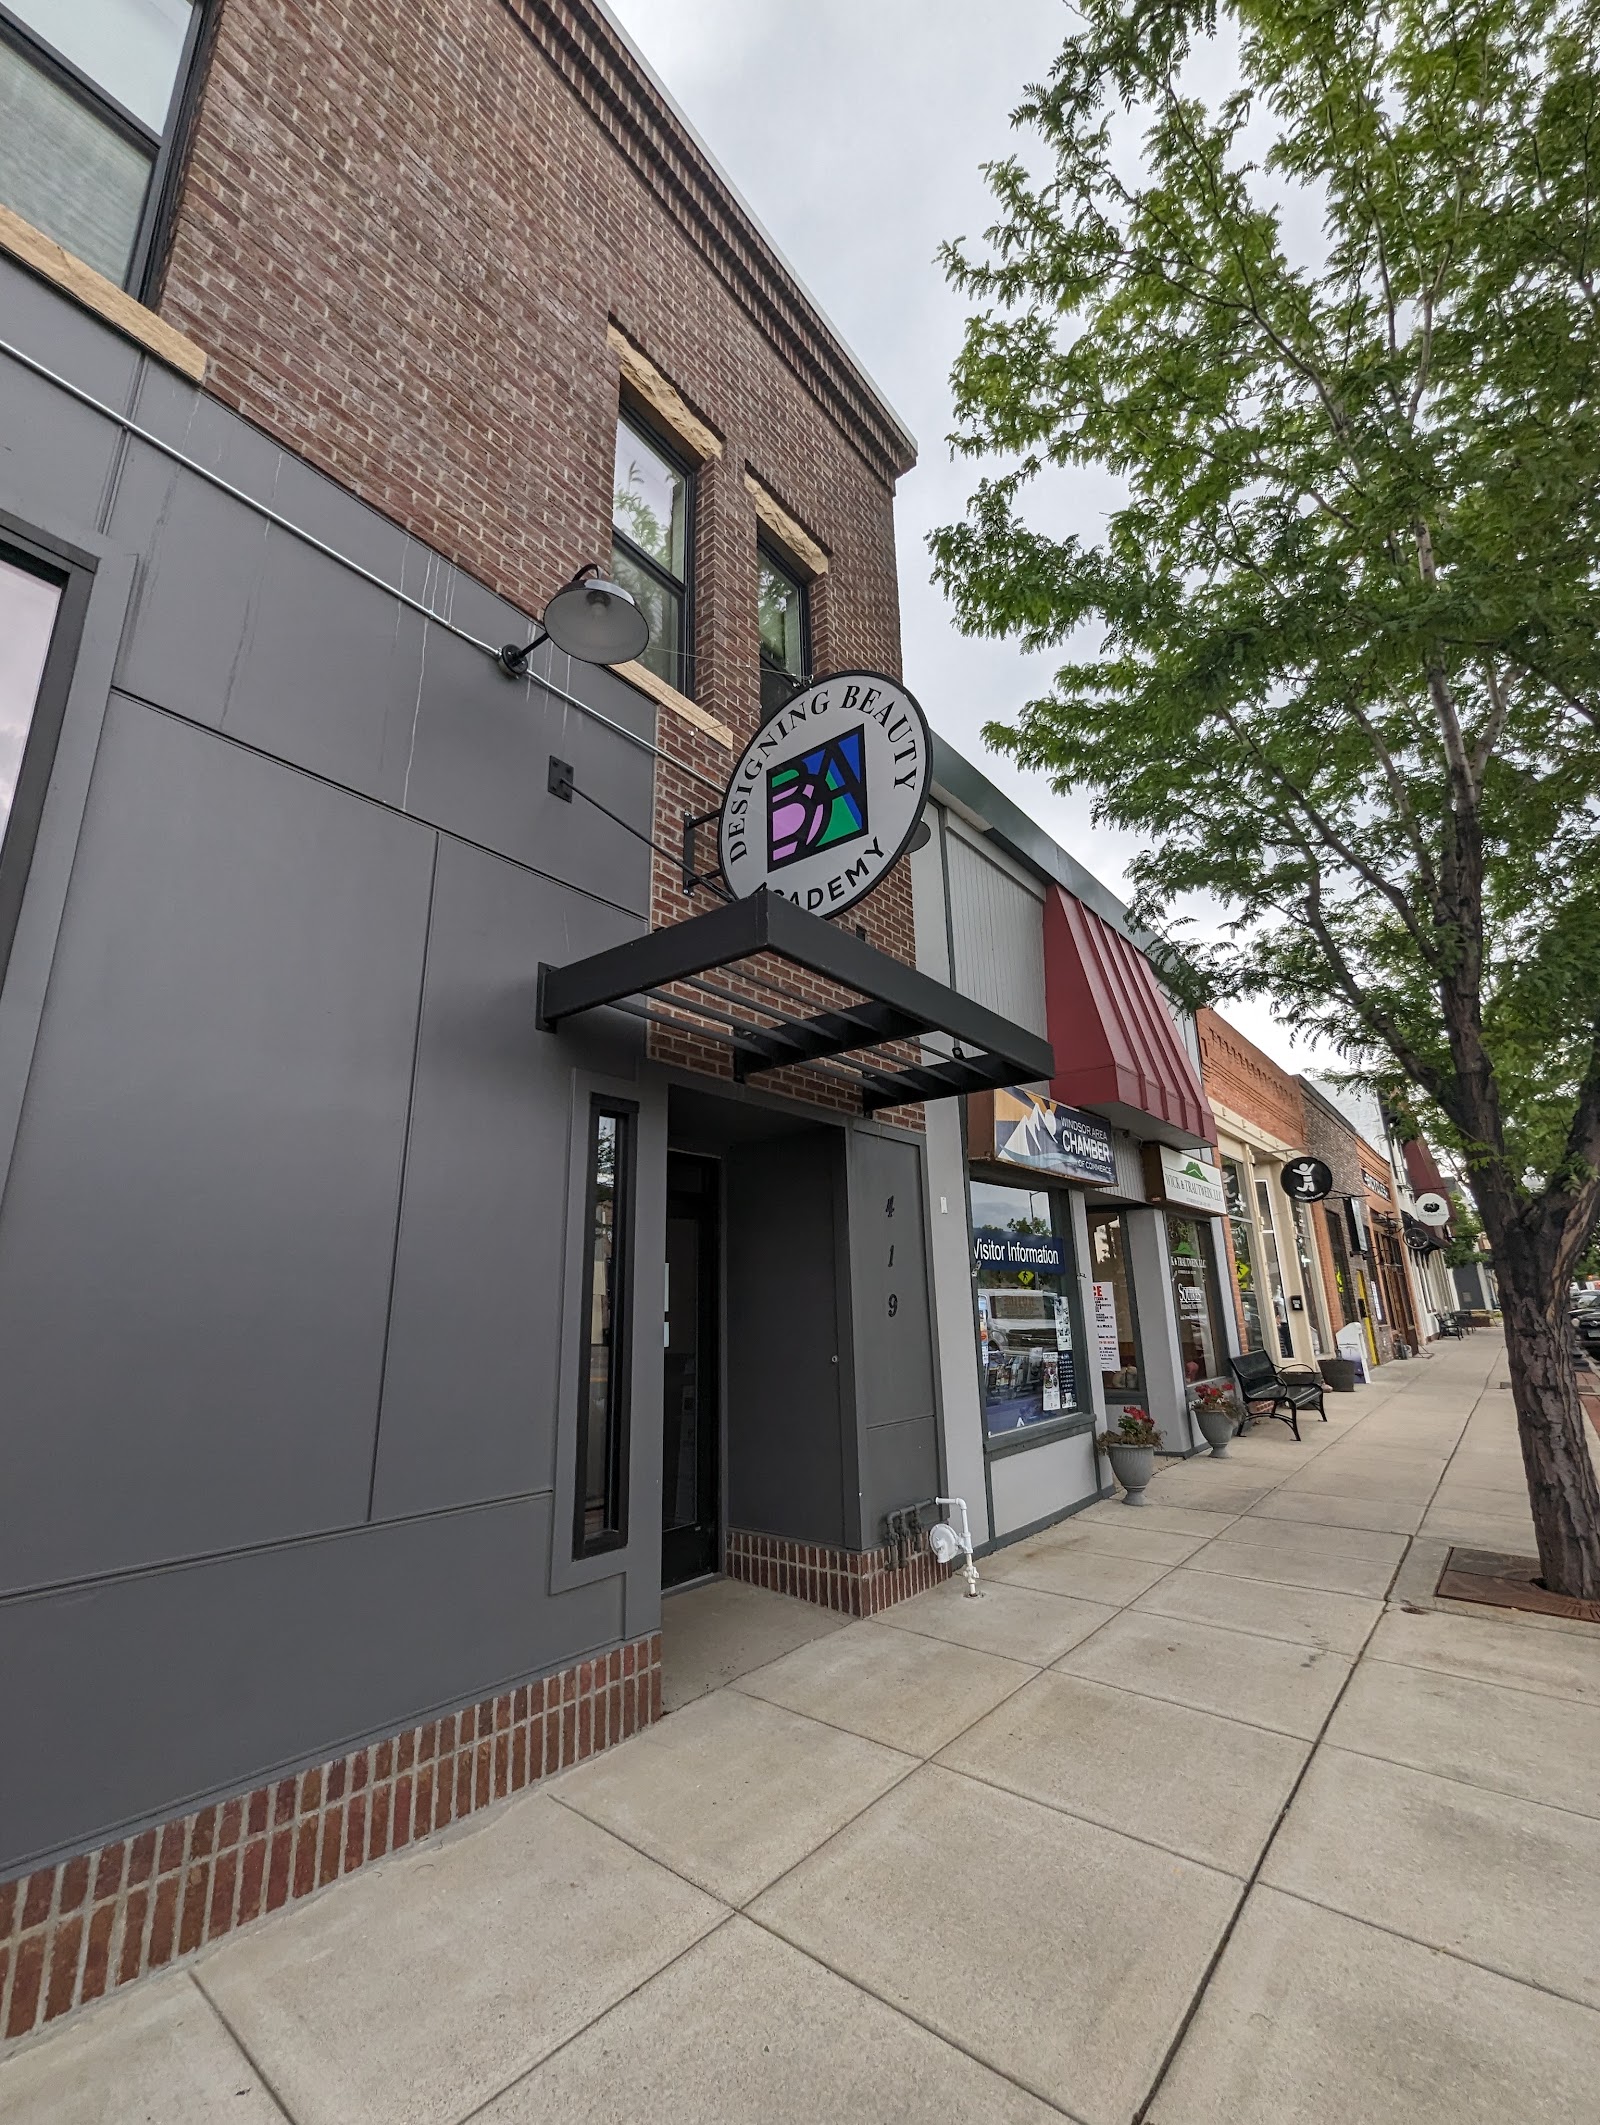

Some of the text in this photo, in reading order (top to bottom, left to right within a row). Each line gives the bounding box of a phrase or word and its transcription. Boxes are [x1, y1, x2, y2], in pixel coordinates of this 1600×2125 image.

[728, 685, 918, 865] DESIGNING BEAUTY
[1061, 1116, 1108, 1141] WINDSOR AREA
[1062, 1130, 1110, 1163] CHAMBER
[1077, 1160, 1112, 1175] OF COMMERCE
[973, 1238, 1059, 1265] Visitor Information
